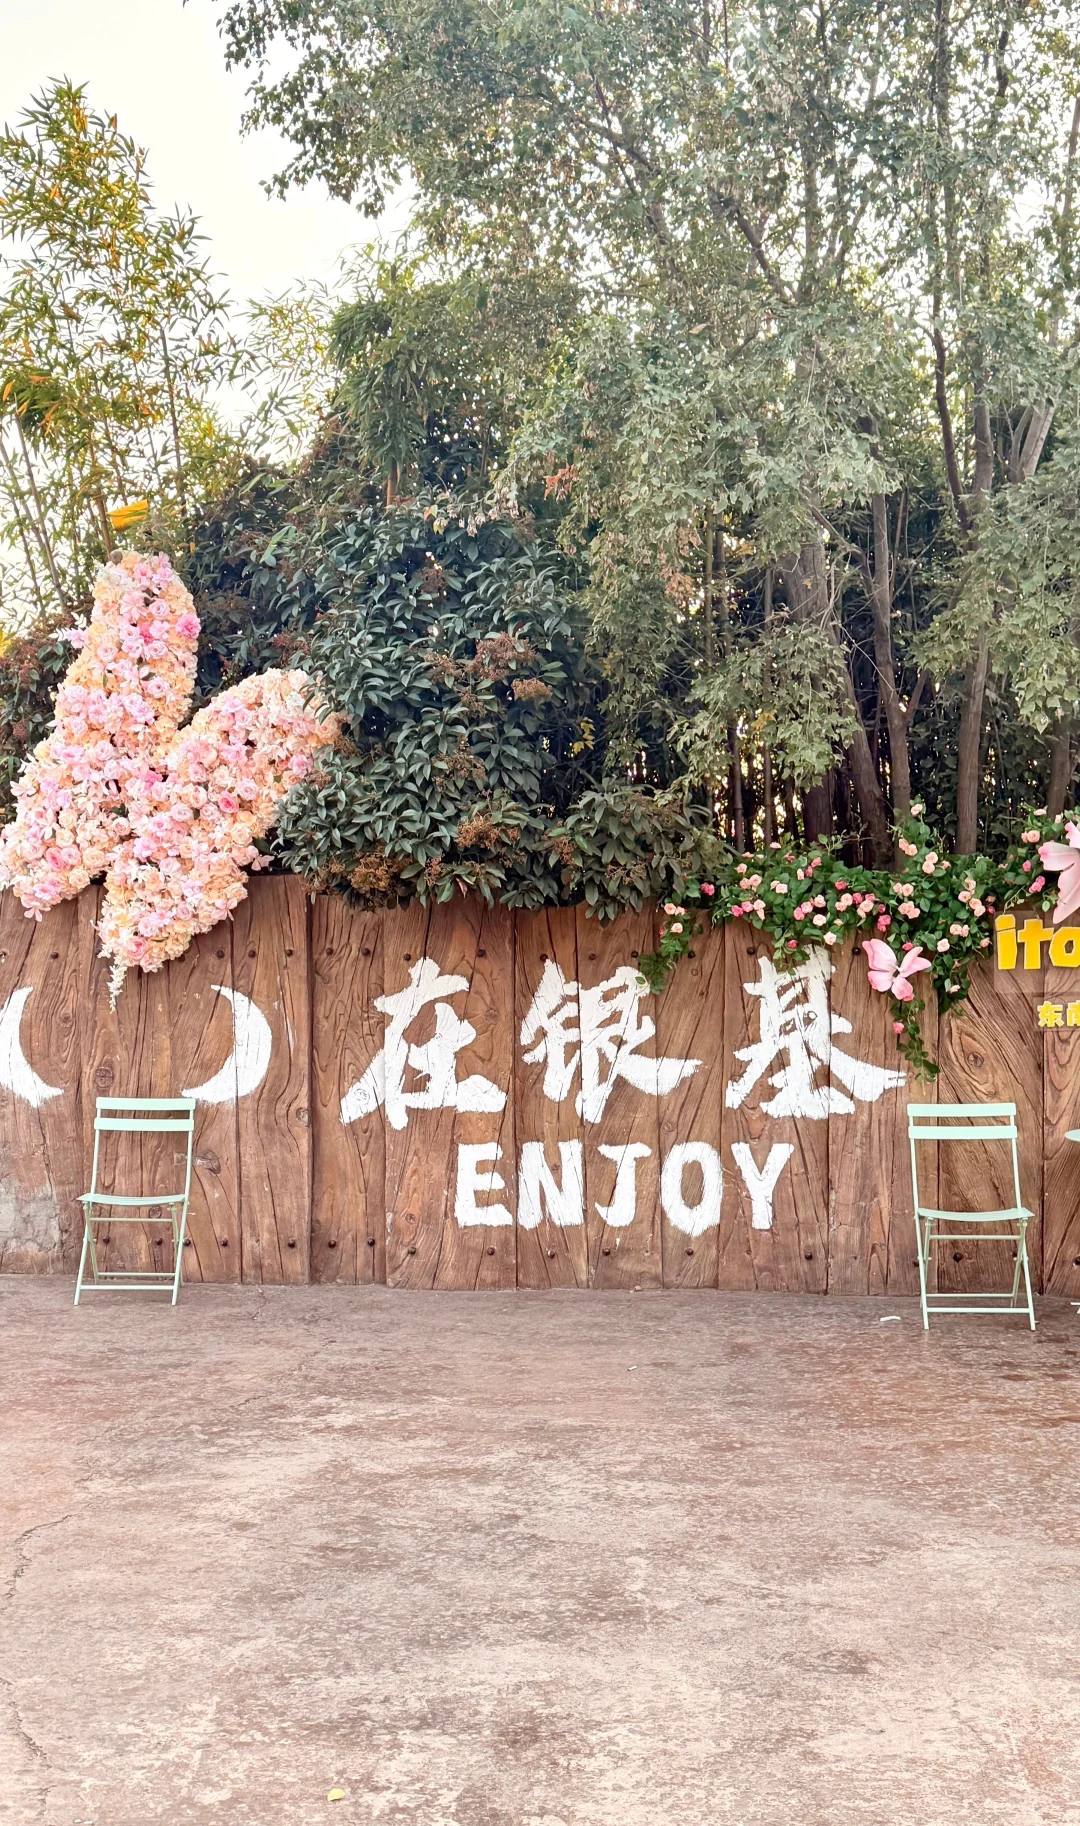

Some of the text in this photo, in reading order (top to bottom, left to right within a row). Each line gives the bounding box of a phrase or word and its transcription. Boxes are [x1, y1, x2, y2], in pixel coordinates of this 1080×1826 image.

[340, 946, 907, 1130] 在银基
[454, 1139, 795, 1236] ENJOY
